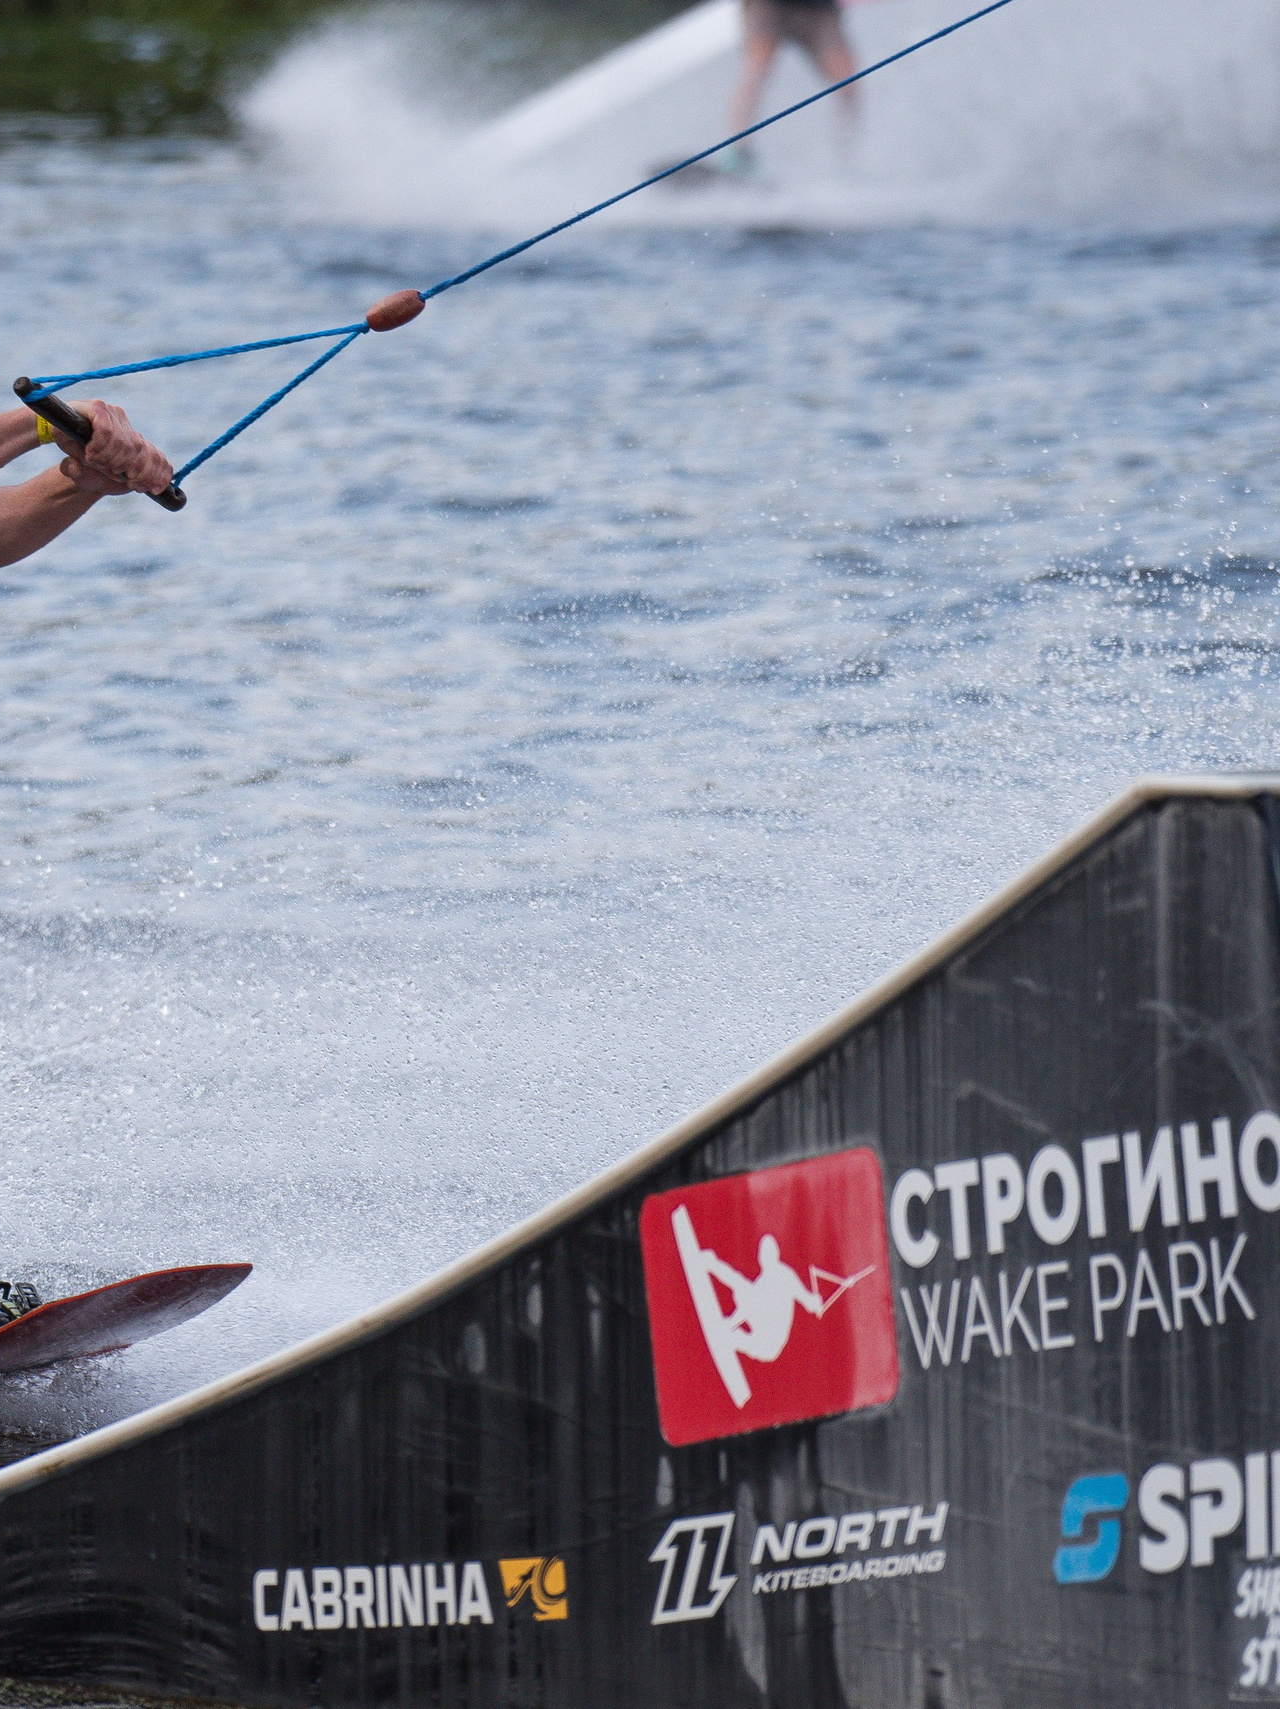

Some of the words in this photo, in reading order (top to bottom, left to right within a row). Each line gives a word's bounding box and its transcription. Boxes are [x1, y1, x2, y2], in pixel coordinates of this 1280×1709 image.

[889, 1110, 1280, 1268] СТРОГИНО
[901, 1261, 1075, 1369] WAKE
[1089, 1233, 1255, 1342] PARK
[750, 1501, 949, 1565] NORTH
[1138, 1452, 1280, 1574] SPI
[253, 1561, 494, 1631] CABRINHA
[752, 1550, 946, 1595] KITEBOARDING
